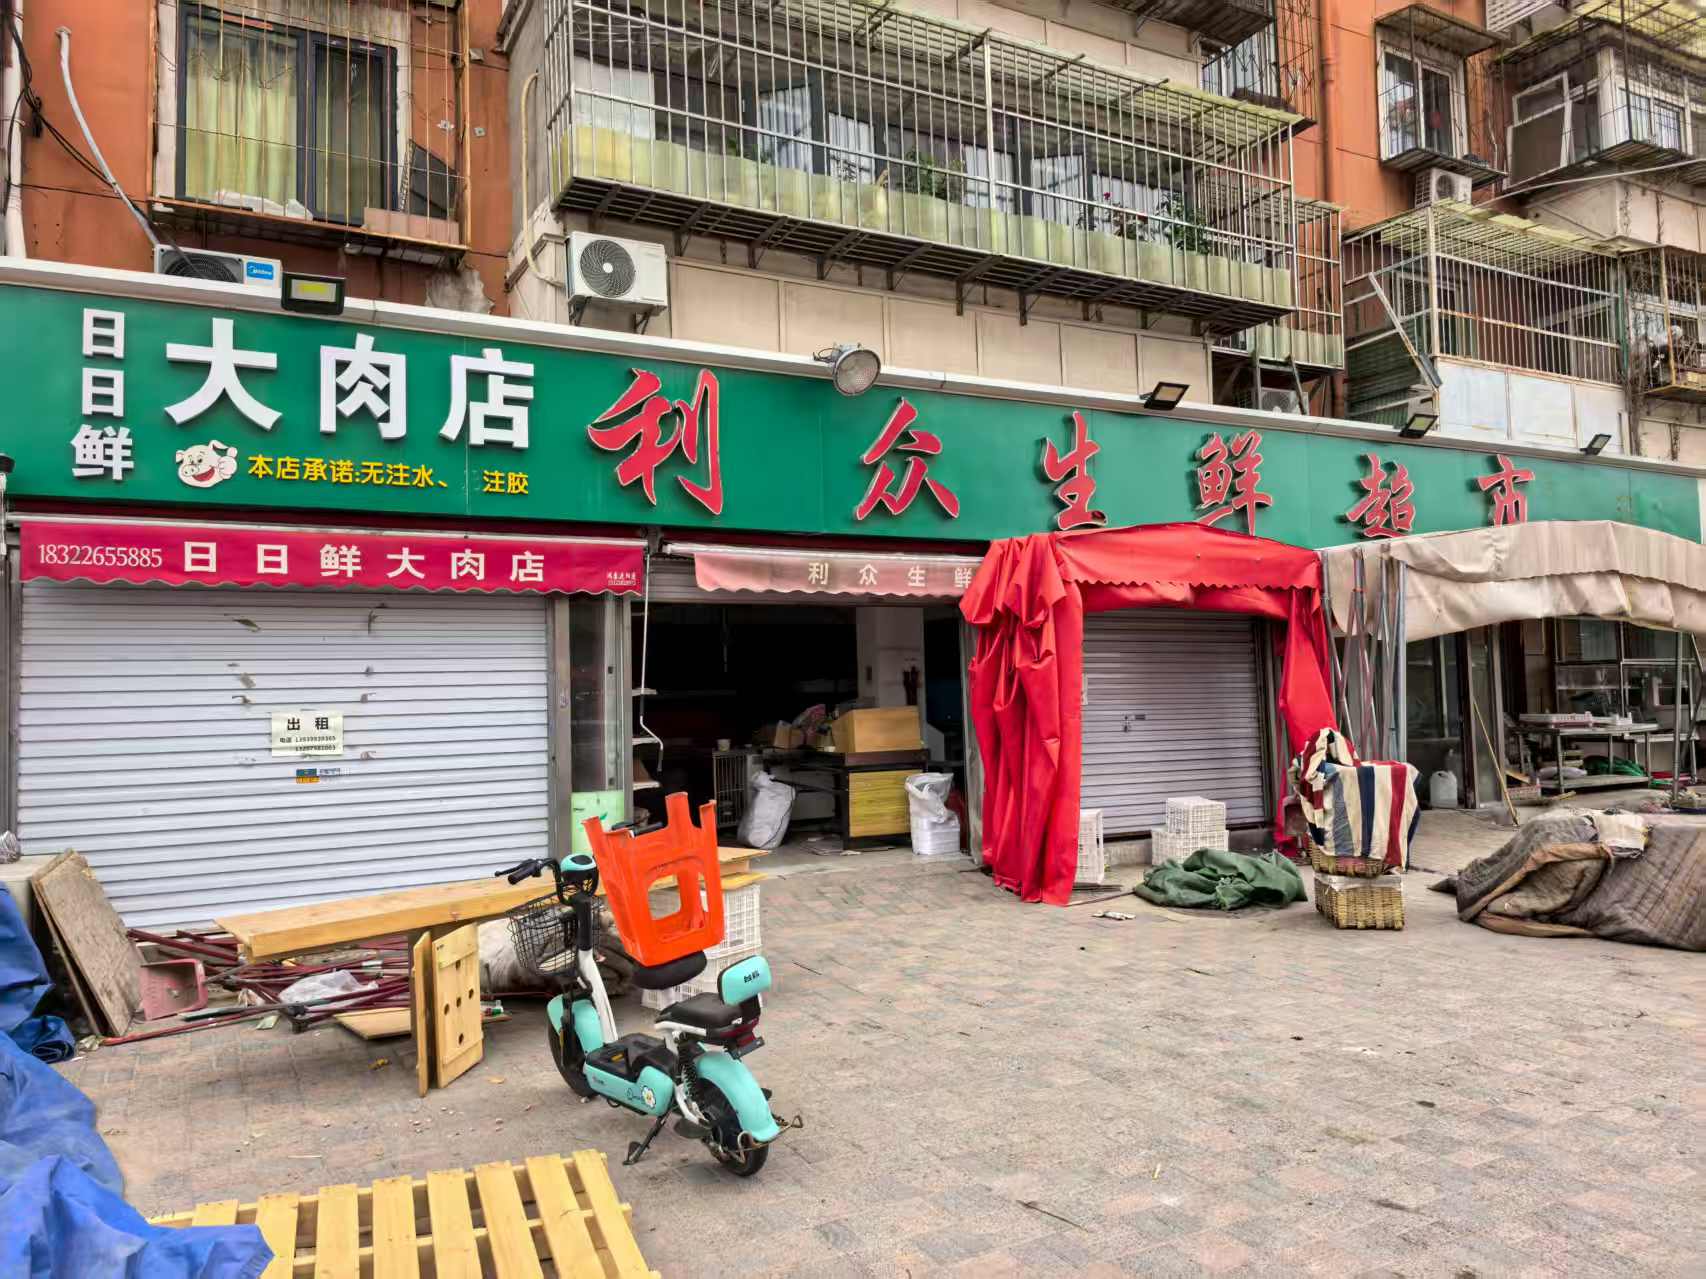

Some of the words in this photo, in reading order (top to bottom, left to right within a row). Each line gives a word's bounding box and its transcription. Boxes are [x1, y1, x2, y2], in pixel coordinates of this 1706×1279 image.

[71, 307, 135, 481] 日日鲜
[164, 317, 536, 449] 大肉店
[586, 367, 1536, 539] 利众生鲜超市
[38, 543, 163, 568] 18322655885
[183, 540, 545, 583] 日日鲜大肉店
[808, 561, 974, 589] 利众生鲜
[287, 717, 329, 730] 出租
